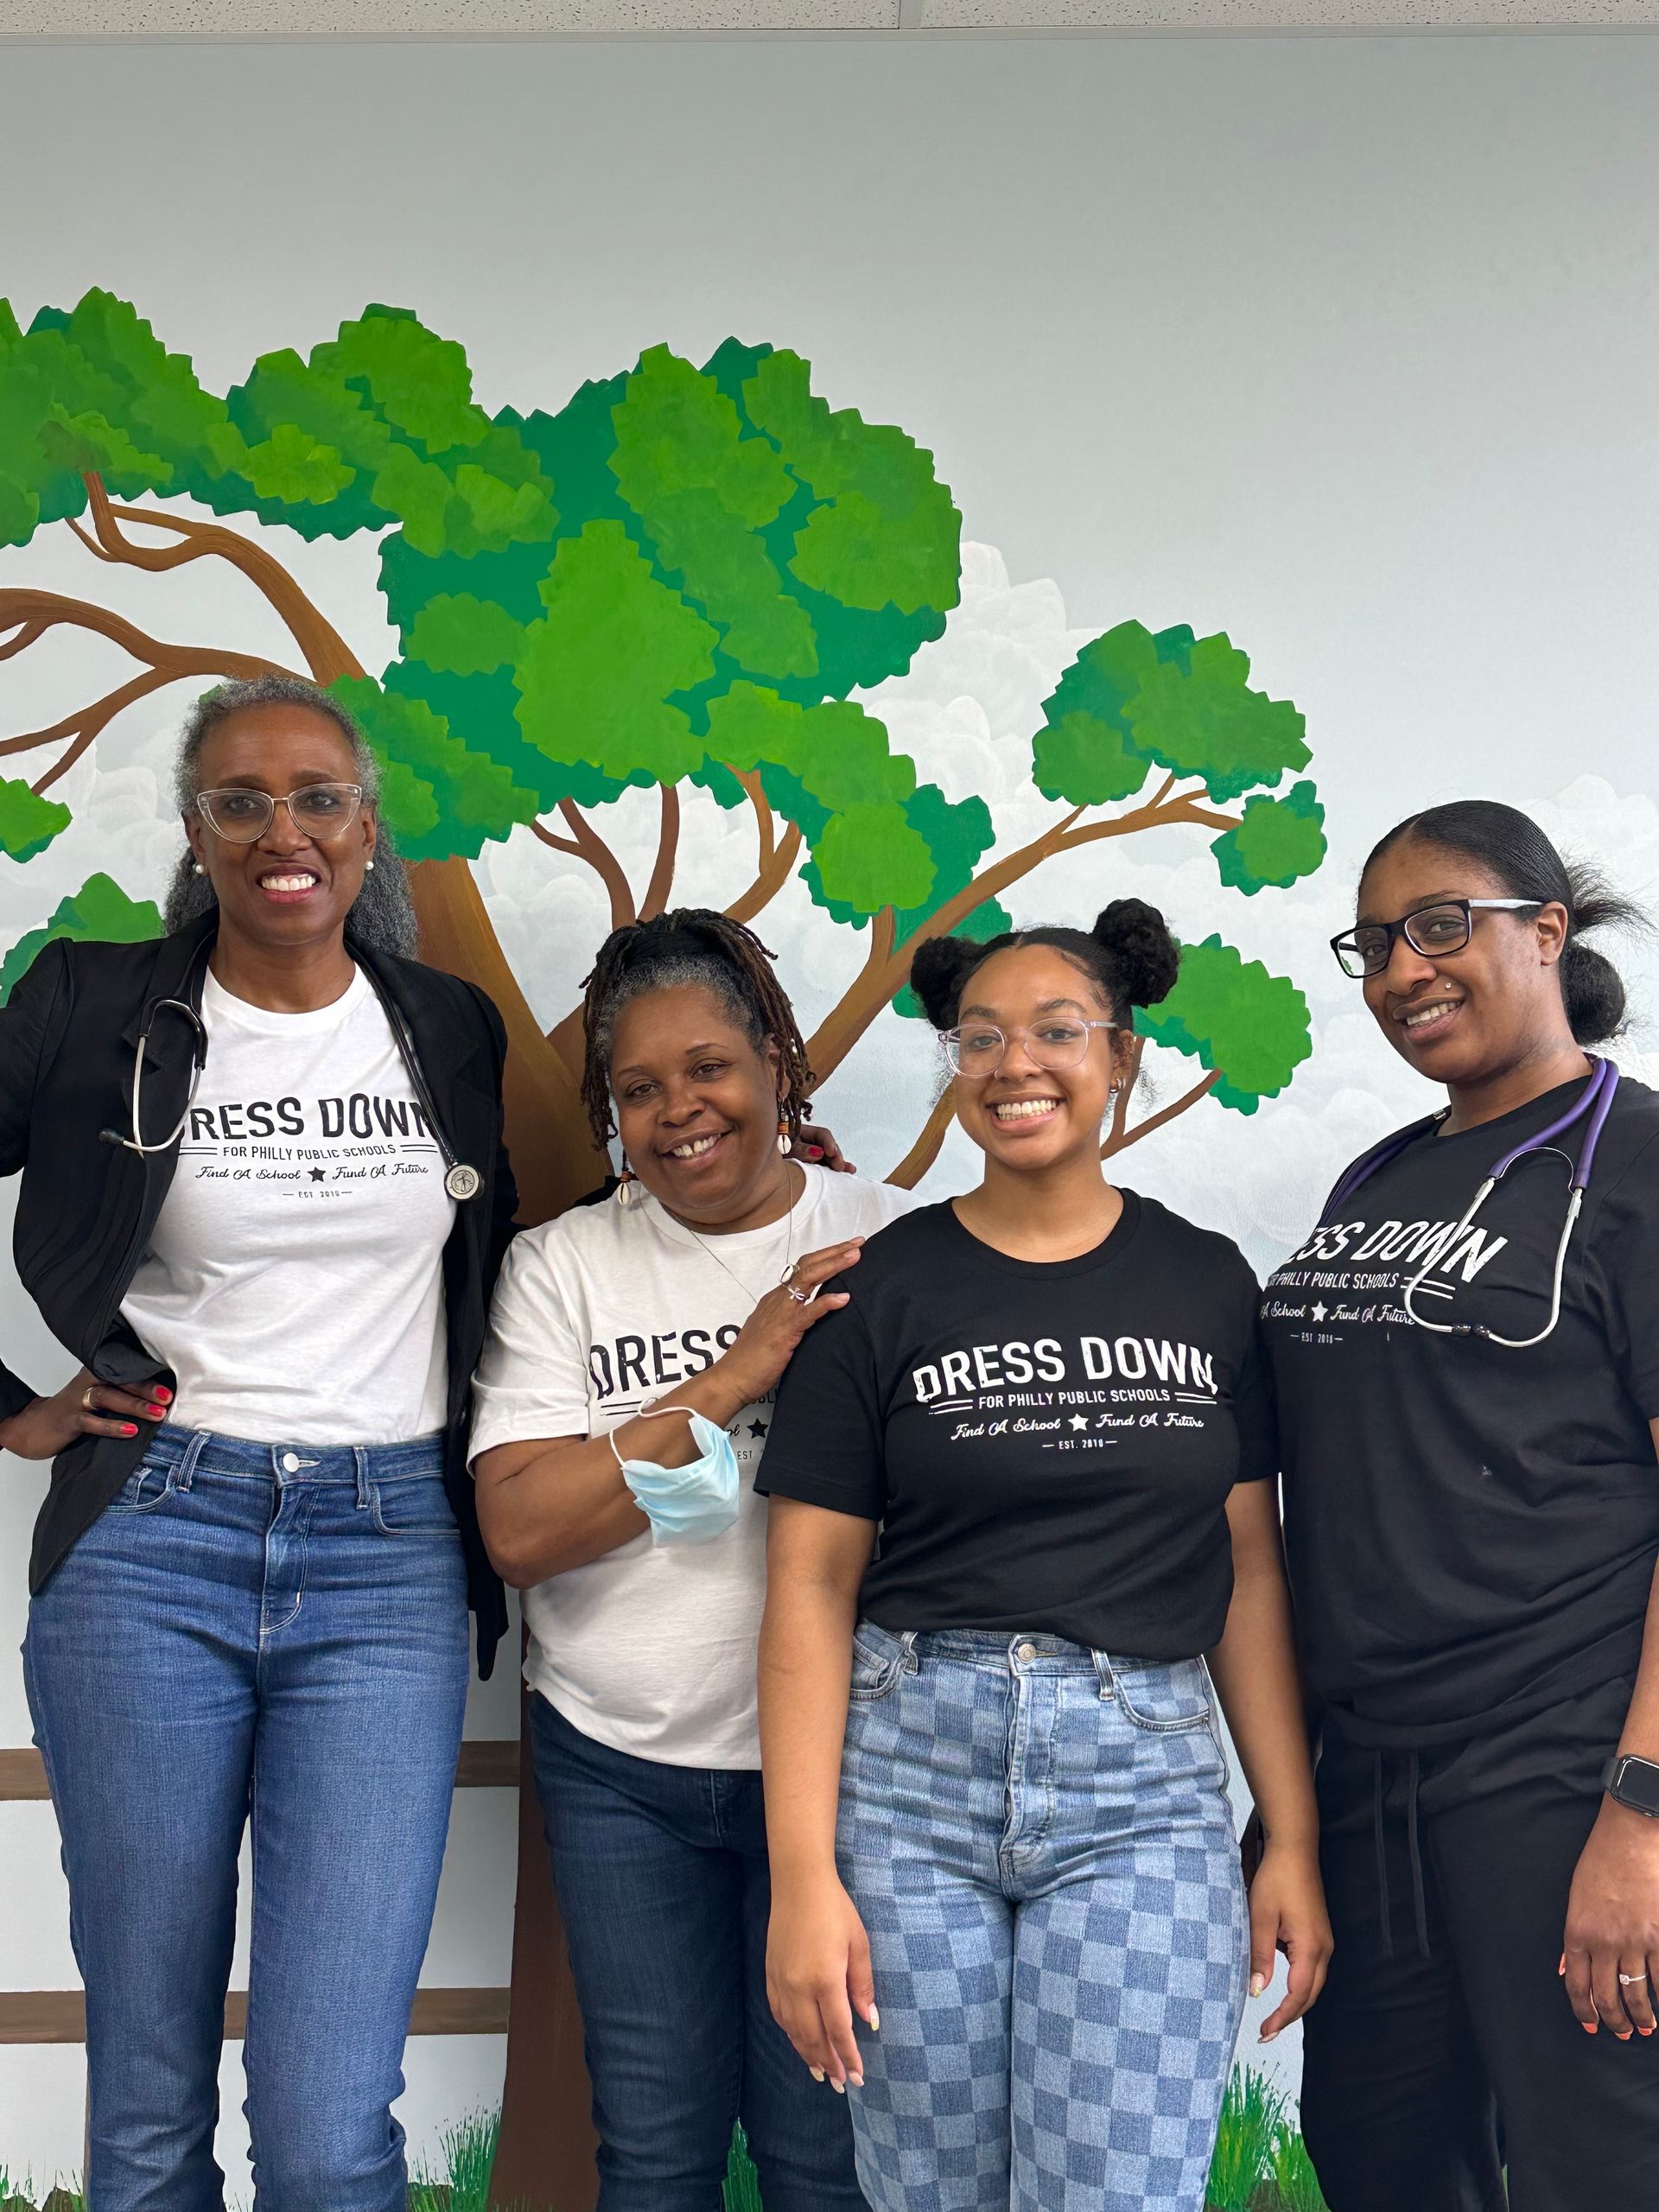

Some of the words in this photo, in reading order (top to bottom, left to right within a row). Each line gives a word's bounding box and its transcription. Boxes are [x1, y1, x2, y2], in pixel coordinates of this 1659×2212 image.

[190, 1096, 304, 1141] RESS
[223, 1147, 247, 1158] FOR
[251, 1146, 293, 1160] PHILLY
[296, 1149, 340, 1160] PUBLIC
[342, 1144, 397, 1157] SCHOOLS
[195, 1166, 229, 1179] Find
[232, 1168, 251, 1180] A
[256, 1168, 301, 1179] School
[332, 1166, 366, 1179] Fund
[370, 1164, 386, 1179] A
[391, 1162, 429, 1176] Future
[1350, 1220, 1509, 1283] DOWN
[1274, 1271, 1312, 1287] PHILLY
[1310, 1272, 1351, 1288] PUBLIC
[1352, 1272, 1400, 1289] SCHOOLS
[1270, 1300, 1306, 1318] School
[1330, 1304, 1360, 1320] Fund
[1361, 1304, 1377, 1323] A
[1376, 1304, 1415, 1325] Future
[912, 1338, 1065, 1402] DRESS
[1080, 1337, 1218, 1395] DOWN
[979, 1395, 1004, 1409] FOR
[1007, 1392, 1053, 1407] PHILLY
[1058, 1390, 1106, 1405] PUBLIC
[1109, 1389, 1171, 1402] SCHOOLS
[950, 1423, 985, 1440] Find
[988, 1418, 1008, 1436] A
[1013, 1417, 1061, 1433] School
[1095, 1413, 1135, 1428] Fund
[1139, 1412, 1159, 1427] A
[1163, 1412, 1205, 1427] Future
[1058, 1440, 1078, 1450] EST.
